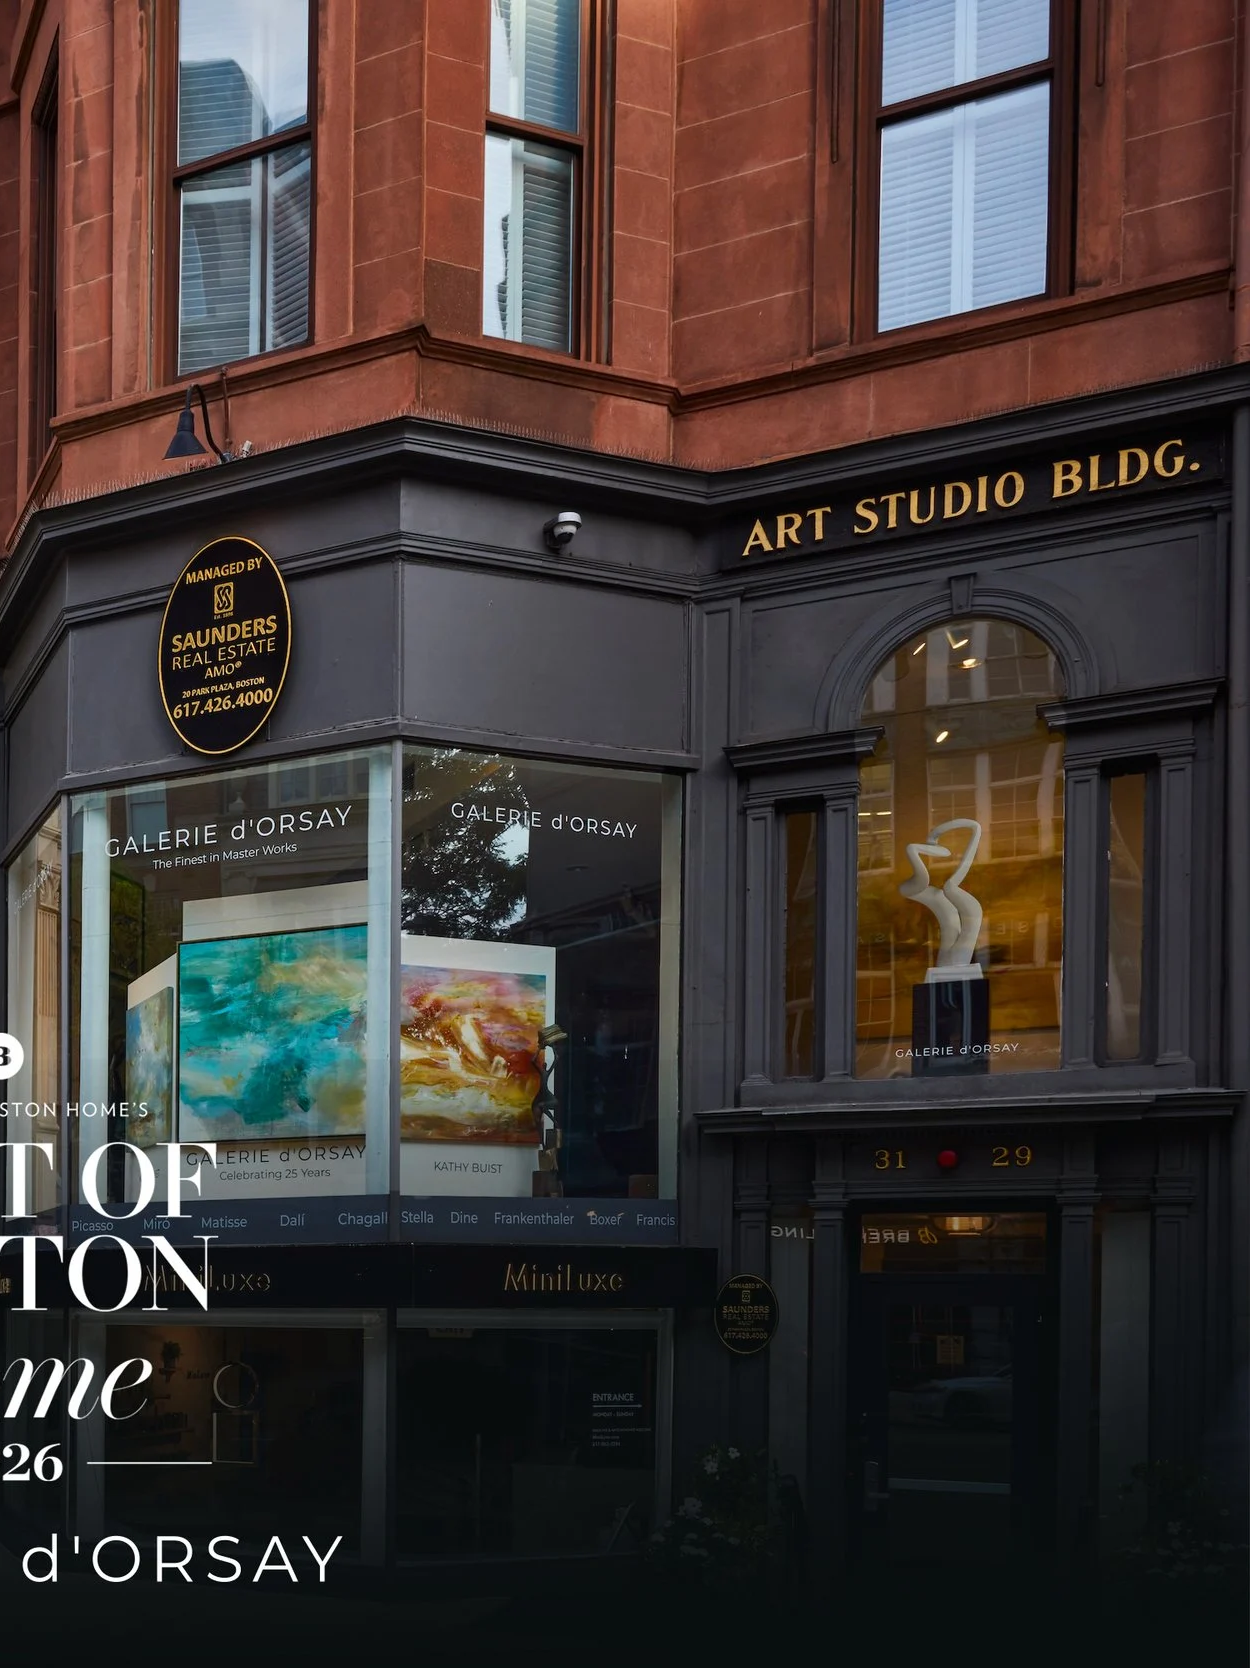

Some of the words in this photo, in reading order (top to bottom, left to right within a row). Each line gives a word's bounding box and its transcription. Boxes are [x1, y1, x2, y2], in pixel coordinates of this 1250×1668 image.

[741, 507, 831, 556] ART
[853, 471, 1025, 534] STUDIO
[1052, 439, 1200, 498] BLDG.
[186, 562, 244, 584] MANAGED
[247, 557, 263, 571] BY
[172, 615, 277, 652] SAUNDERS
[172, 651, 212, 671] REAL
[218, 637, 276, 661] ESTATE
[182, 690, 191, 698] 20
[192, 687, 210, 697] PARK
[211, 682, 235, 693] PLAZA,
[236, 676, 265, 689] BOSTON
[173, 688, 273, 719] 617.426.4000
[105, 824, 217, 857] GALERIE
[231, 805, 352, 841] d'ORSAY
[451, 803, 542, 828] GALERIE
[551, 813, 637, 839] d'ORSAY
[152, 857, 173, 870] The
[175, 852, 207, 867] Finest
[209, 851, 220, 863] in
[223, 847, 259, 861] Master
[262, 842, 297, 856] Works
[895, 1046, 953, 1058] GALERIE
[959, 1043, 1019, 1055] d'ORSAY
[186, 1149, 269, 1165] GALERIE
[280, 1145, 366, 1162] d'ORSAY
[874, 1149, 907, 1170] 31
[991, 1146, 1033, 1167] 29
[219, 1168, 282, 1181] Celebrating
[285, 1168, 298, 1179] 25
[300, 1167, 331, 1179] Years
[434, 1161, 470, 1173] KATHY
[472, 1163, 503, 1174] BUIST
[72, 1220, 114, 1233] Picasso
[143, 1217, 171, 1231] Miró
[201, 1217, 248, 1229] Matisse
[280, 1213, 305, 1227] Dalí
[338, 1211, 388, 1228] Chagall
[401, 1211, 434, 1224] Stella
[450, 1211, 478, 1224] Dine
[494, 1212, 575, 1225] Frankenthaler
[590, 1213, 622, 1225] Boxer
[636, 1214, 676, 1227] Francis
[504, 1263, 624, 1292] MiniLuxe
[722, 1305, 770, 1314] SAUNDERS
[592, 1393, 635, 1401] ENTRANCE
